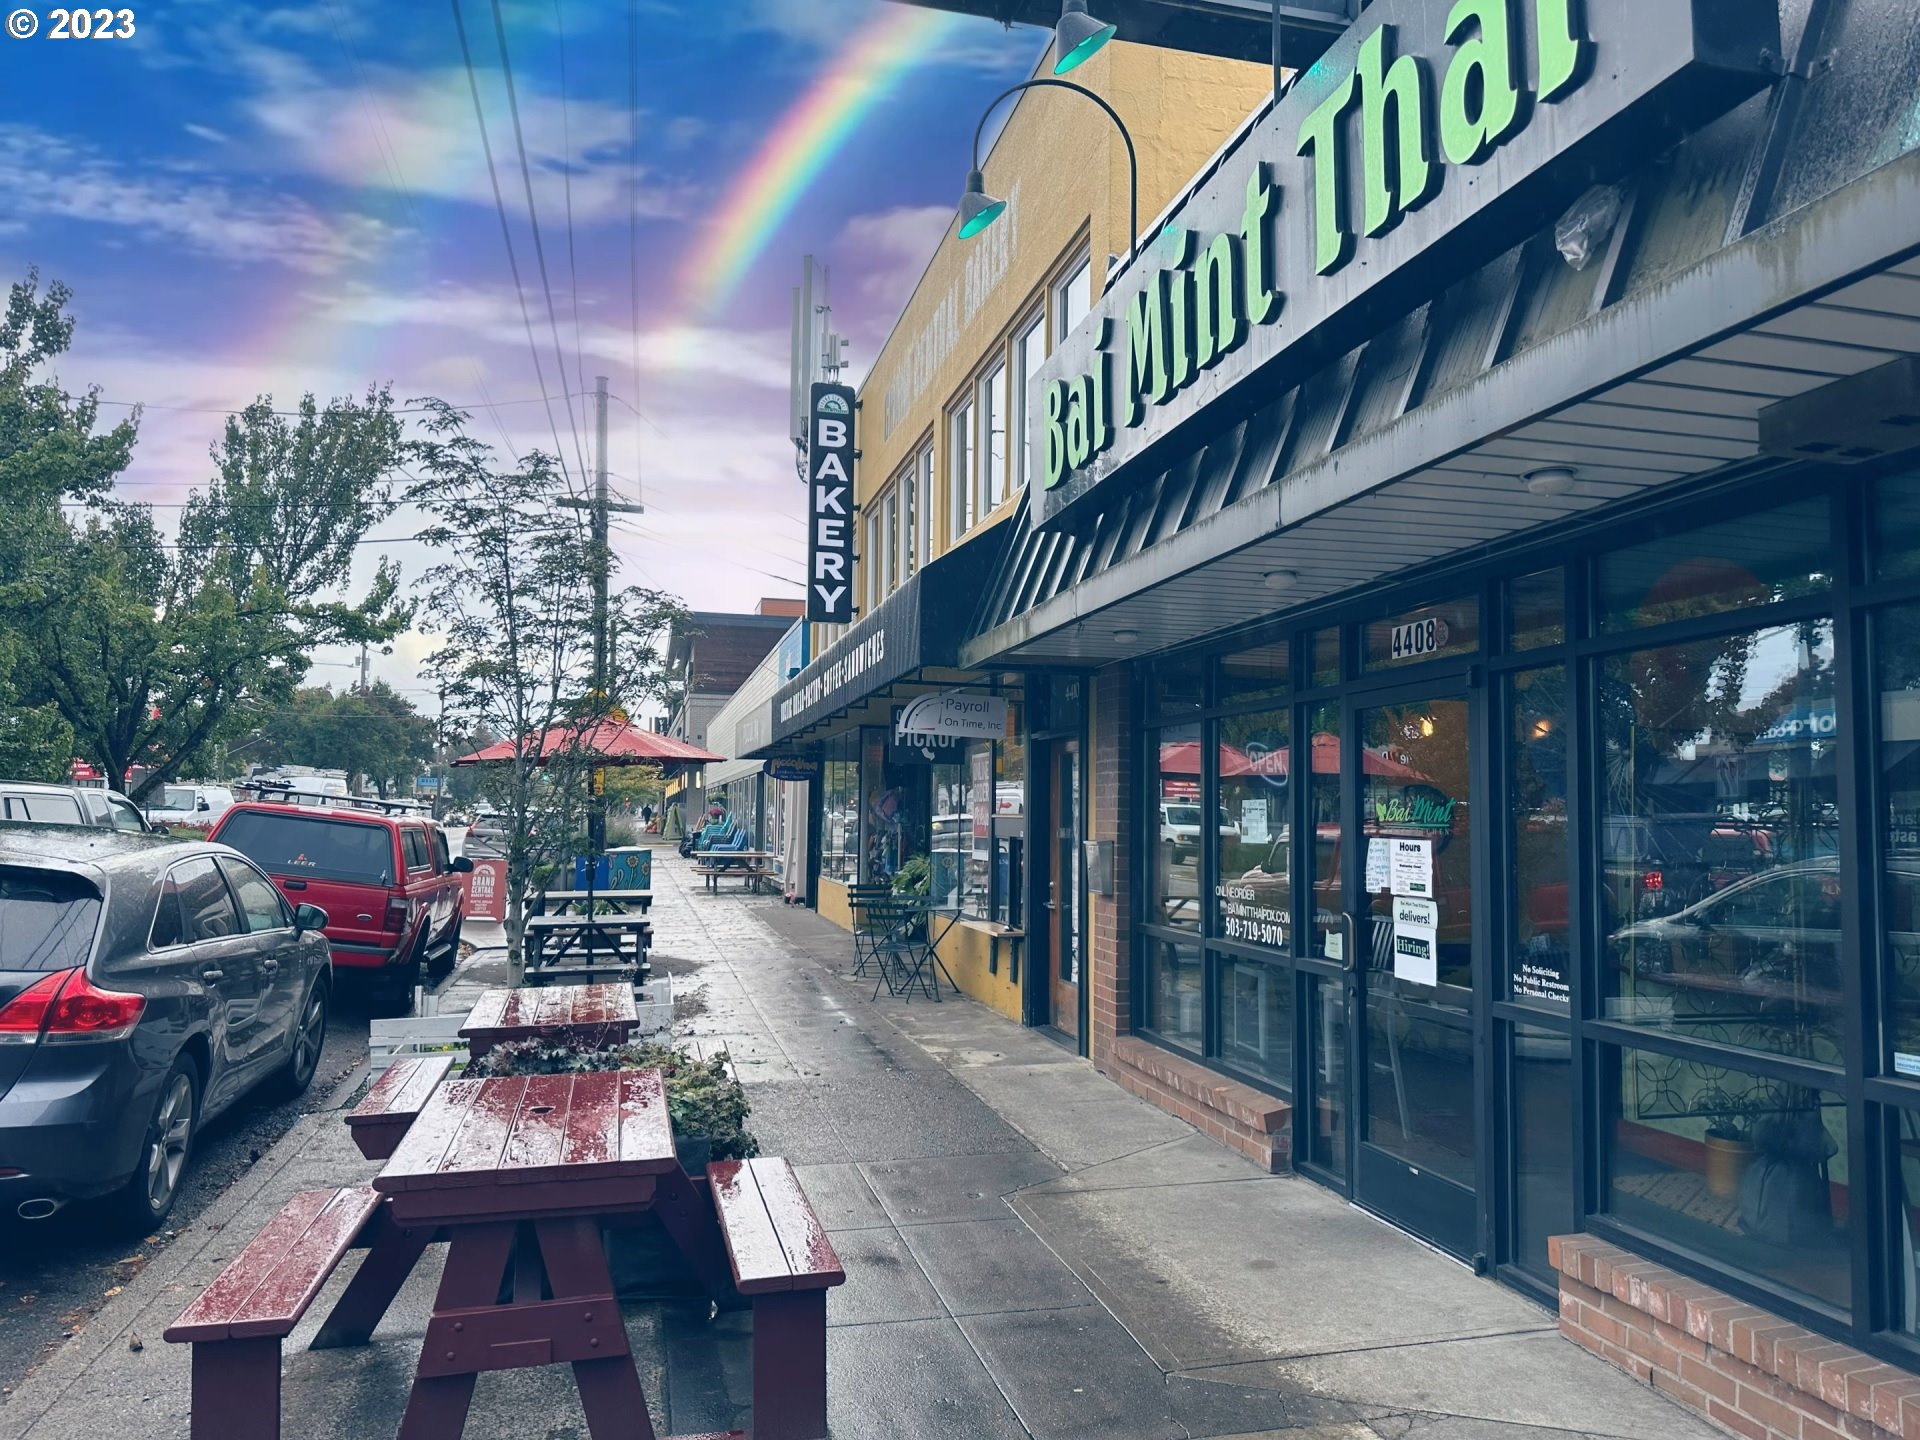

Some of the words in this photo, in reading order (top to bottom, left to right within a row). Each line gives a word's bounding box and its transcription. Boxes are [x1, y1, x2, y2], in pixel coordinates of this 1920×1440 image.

[1044, 318, 1110, 491] Bai
[1124, 160, 1275, 428] Mint
[814, 418, 849, 613] BAKERY
[1393, 619, 1435, 657] 4408
[844, 629, 884, 684] SANDWICHES
[946, 698, 990, 714] Payroll
[944, 717, 960, 728] On
[960, 718, 986, 731] Time,
[1249, 751, 1283, 773] OPEN
[1386, 798, 1410, 821] Bai
[1410, 794, 1456, 823] Mint
[1399, 841, 1421, 852] Hours
[287, 859, 317, 867] LEER
[472, 876, 495, 886] GRAND
[1399, 909, 1430, 925] delivers!
[1225, 917, 1283, 946] 503-719-5070
[1397, 938, 1430, 959] Hiring!
[1513, 973, 1522, 982] No
[1523, 975, 1540, 986] Public
[1522, 964, 1531, 973] No
[1532, 965, 1560, 980] Soliciting
[1513, 984, 1522, 994] No
[1523, 986, 1547, 998] Personal
